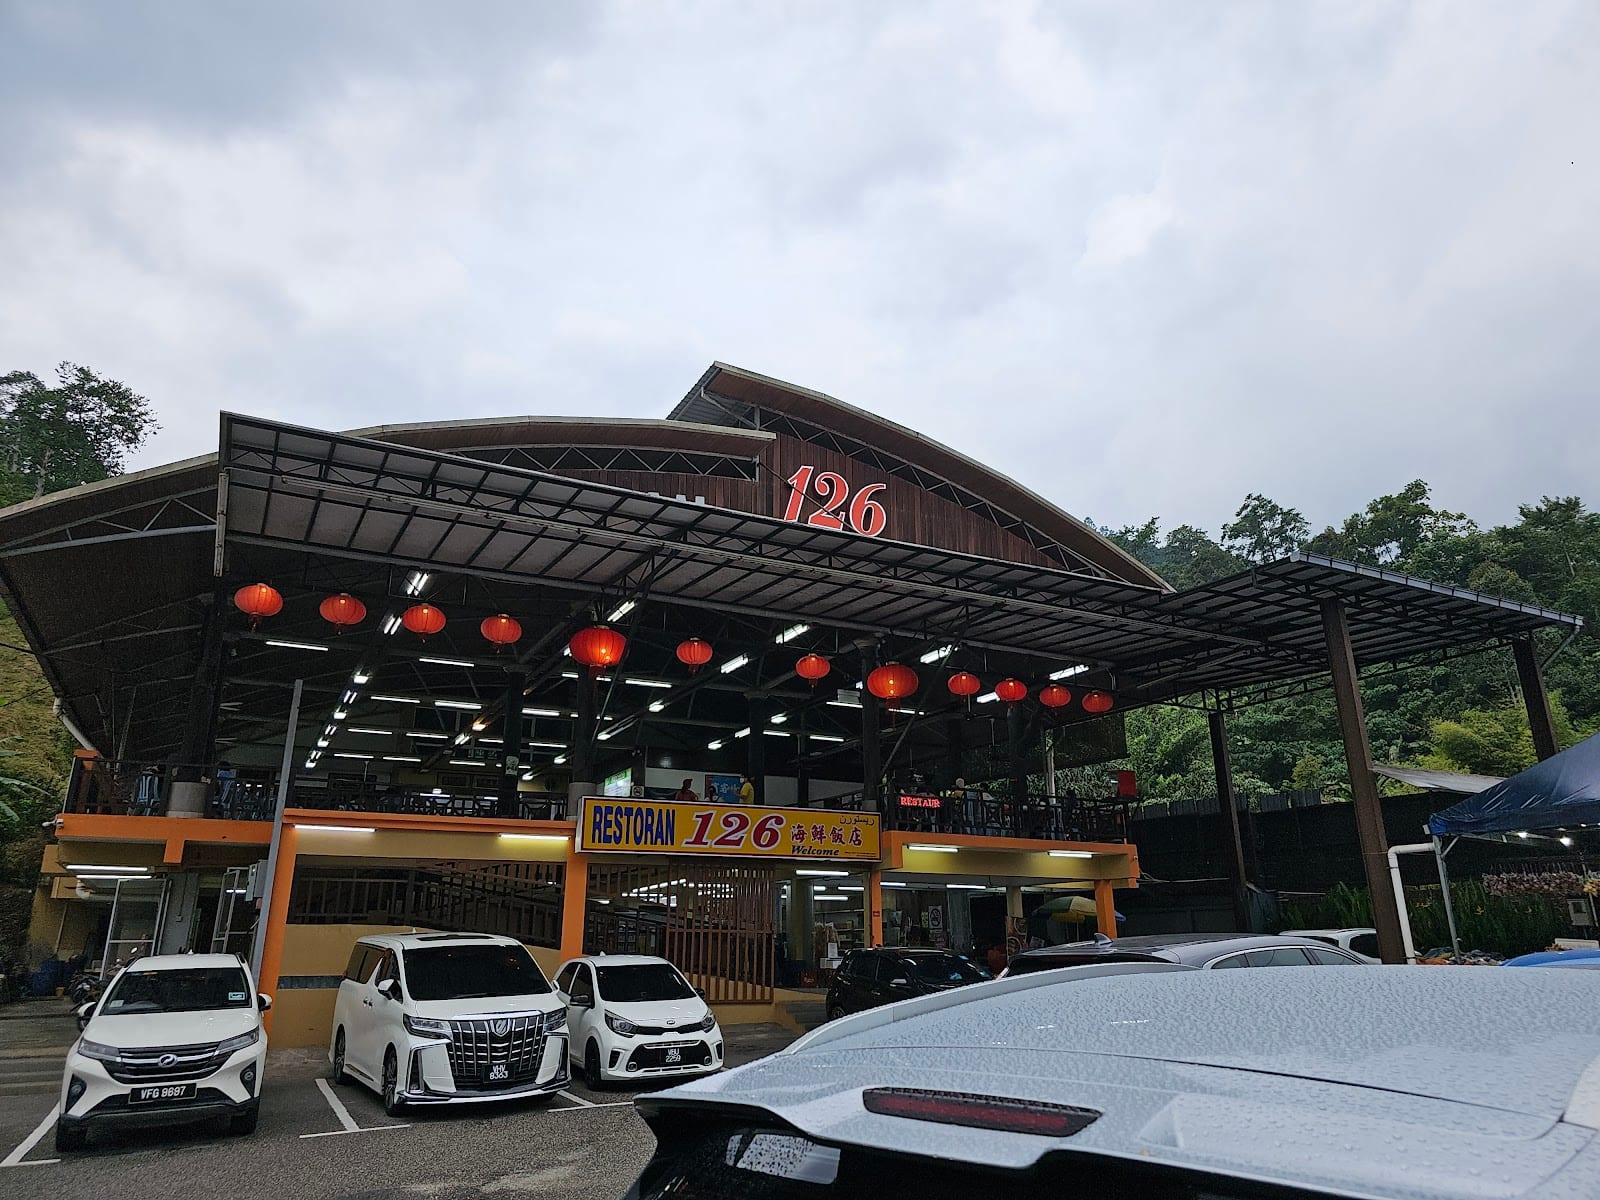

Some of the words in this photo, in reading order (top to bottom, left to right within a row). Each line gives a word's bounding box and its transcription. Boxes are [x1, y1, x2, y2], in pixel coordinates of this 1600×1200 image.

[784, 465, 886, 536] 126
[591, 805, 676, 846] RESTORAN
[681, 810, 786, 850] 126
[791, 823, 863, 846] 海鮮飯店
[791, 844, 840, 856] Welcome
[141, 1088, 159, 1099] VFG
